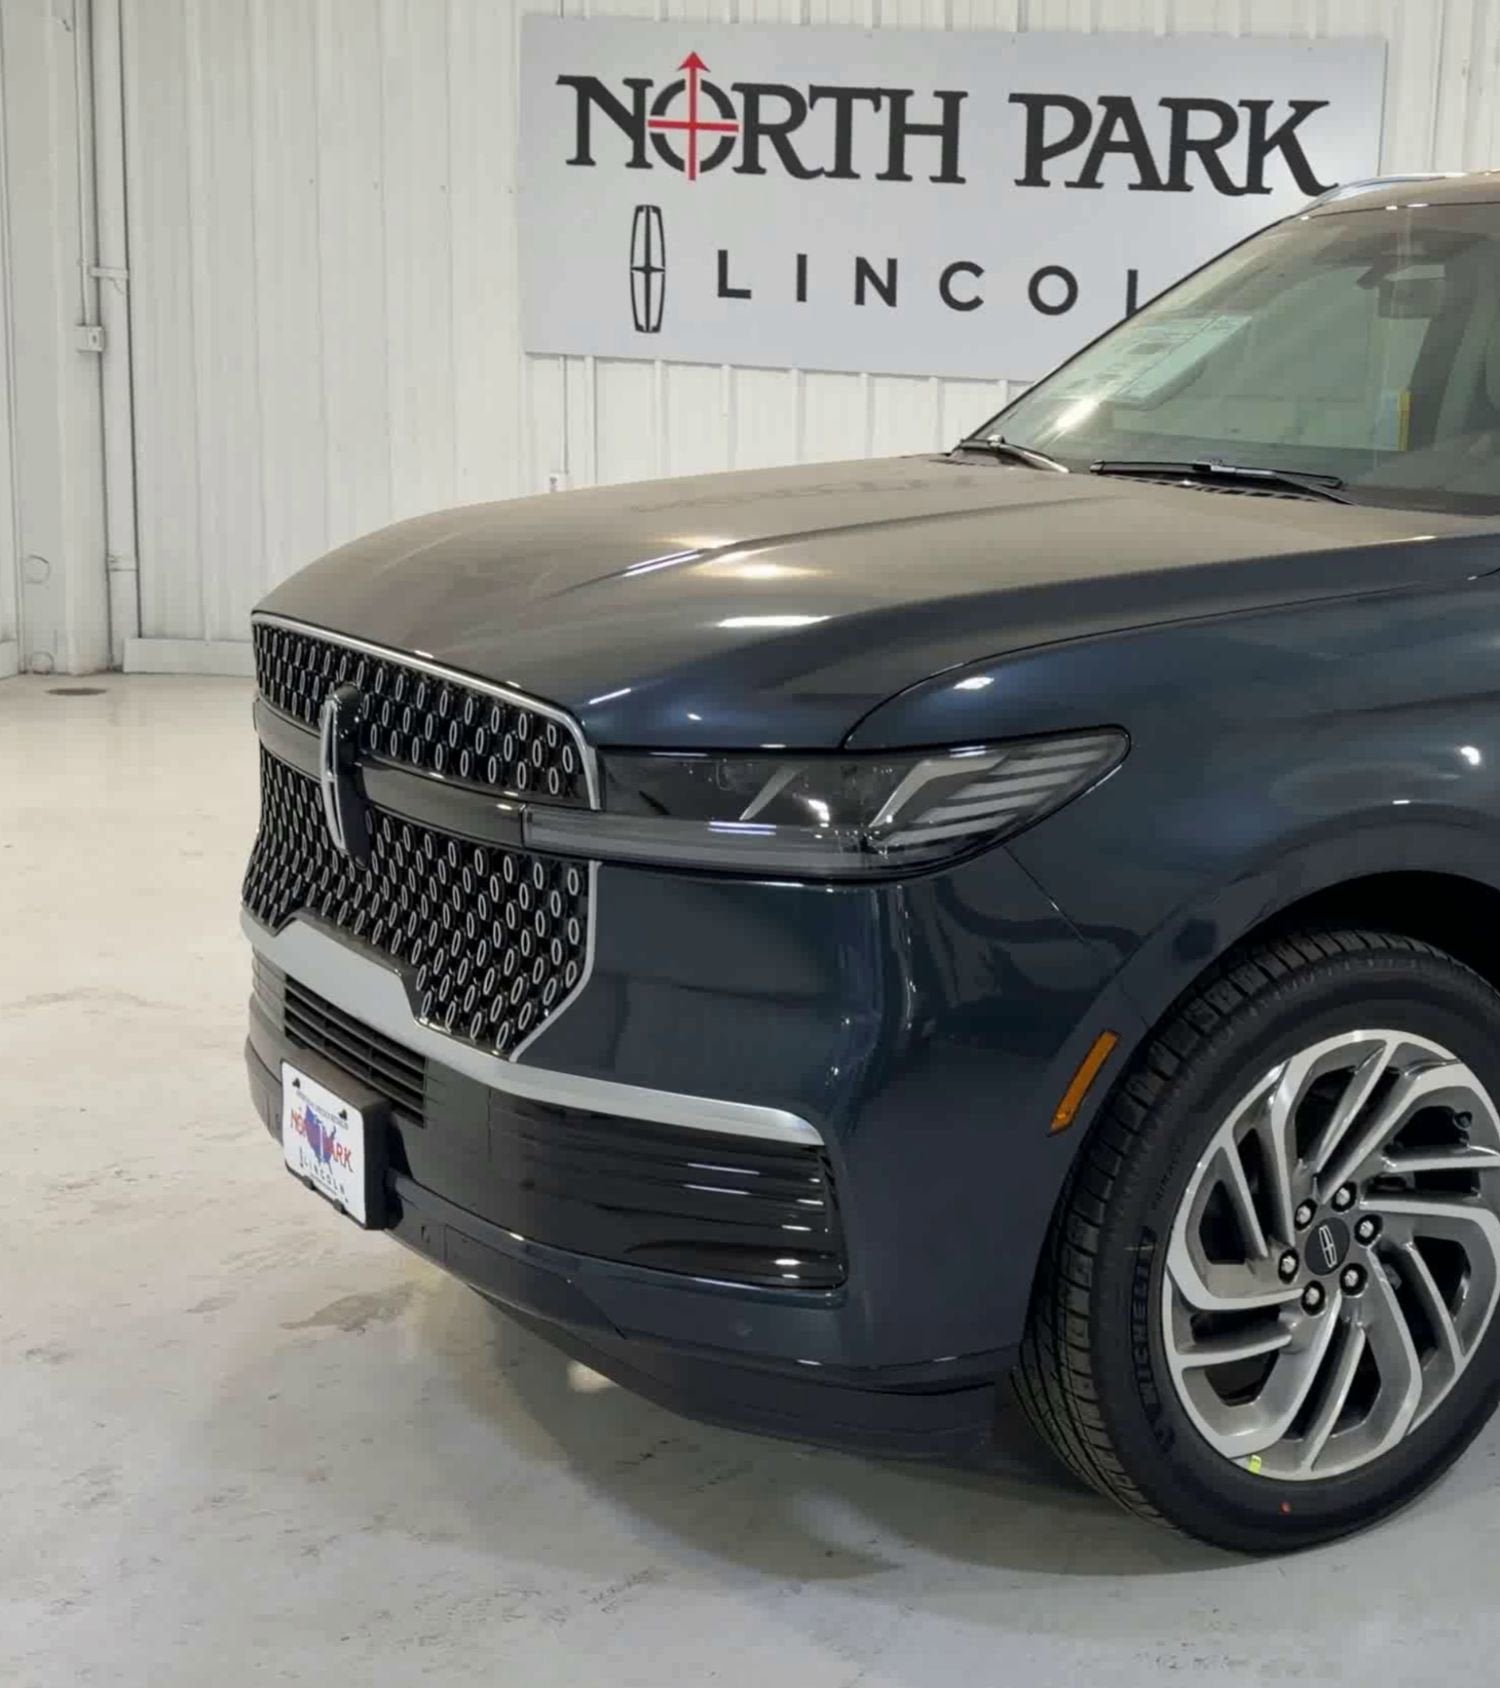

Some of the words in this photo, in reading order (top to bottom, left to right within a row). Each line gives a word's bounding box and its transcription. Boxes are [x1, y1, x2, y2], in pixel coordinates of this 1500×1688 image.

[556, 74, 968, 185] NORTH
[1007, 92, 1338, 197] PARK
[1131, 1235, 1158, 1407] MICHELIN
